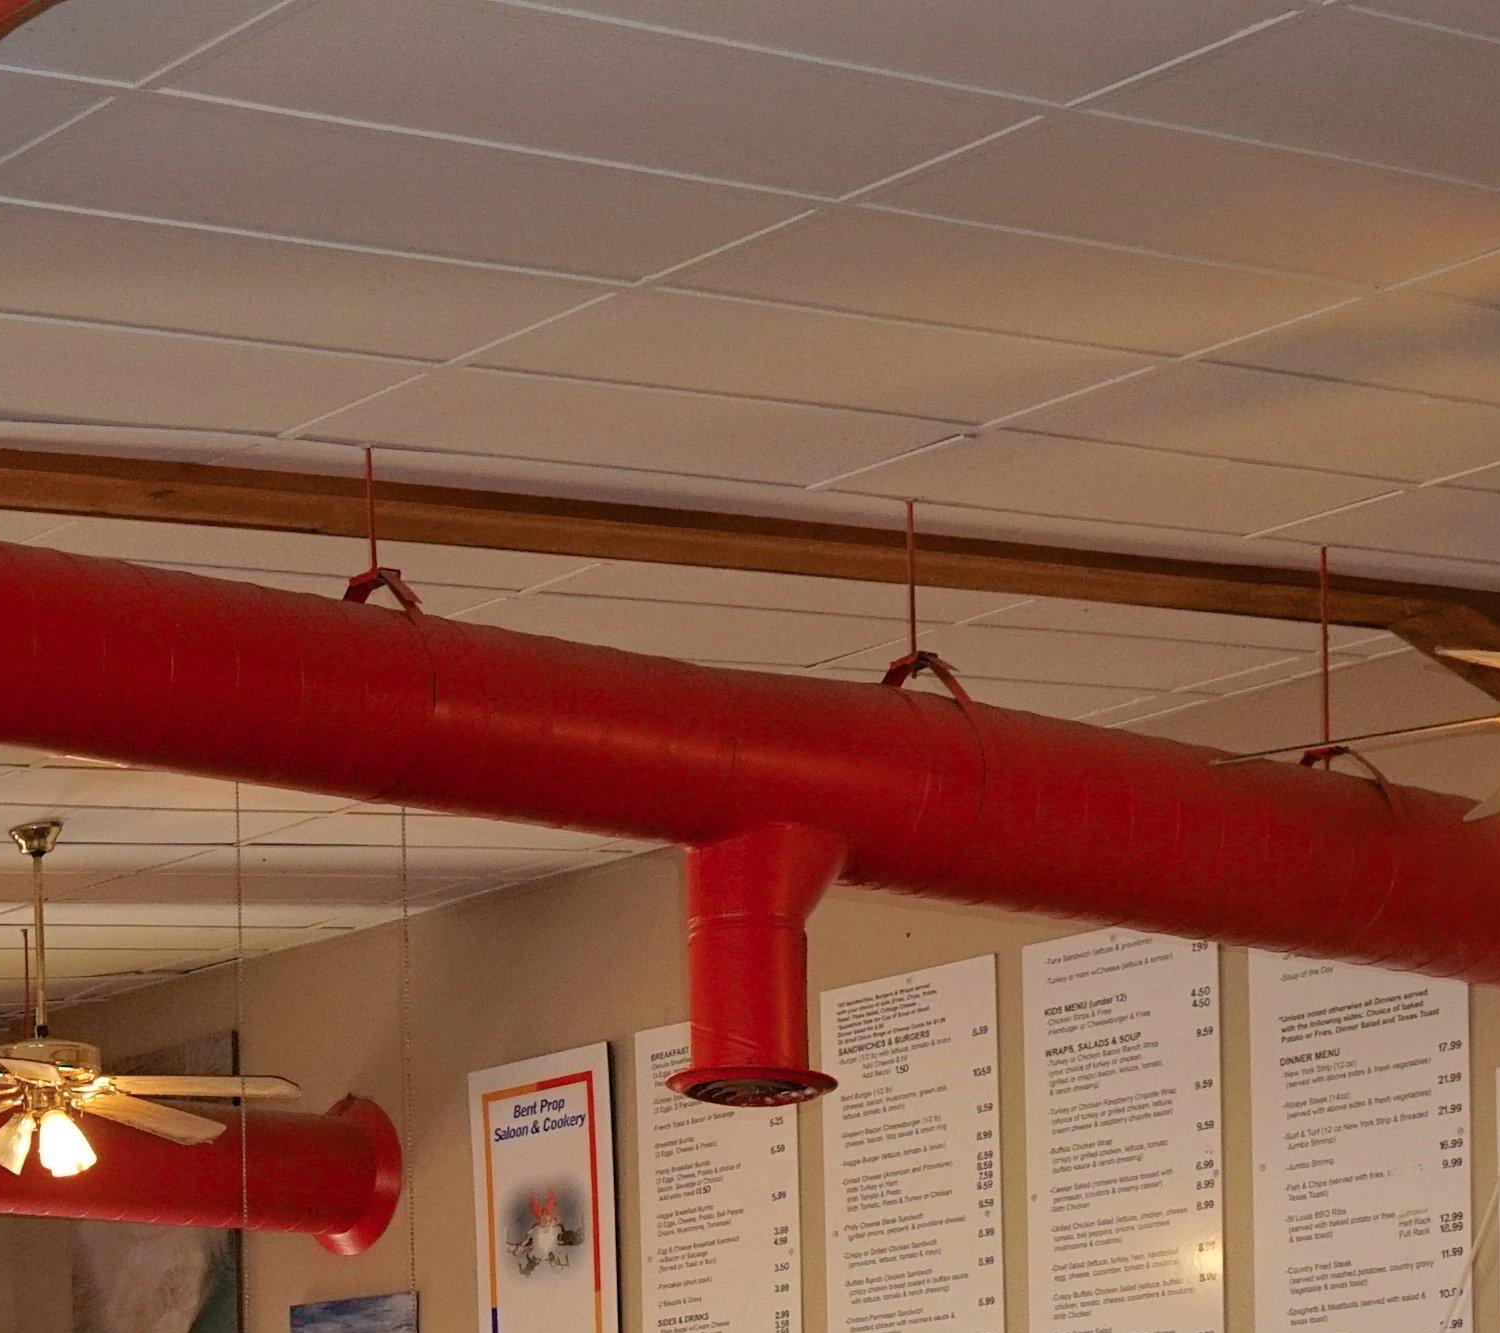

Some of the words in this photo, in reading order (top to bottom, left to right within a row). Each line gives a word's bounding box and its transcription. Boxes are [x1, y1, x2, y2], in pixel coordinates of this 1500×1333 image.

[1280, 1052, 1312, 1067] DINNER
[1314, 1048, 1341, 1062] MENU
[513, 1102, 536, 1119] Bent
[540, 1098, 565, 1113] Prop
[494, 1125, 528, 1142] Saloon
[531, 1120, 540, 1135] &
[543, 1113, 586, 1132] Cookery
